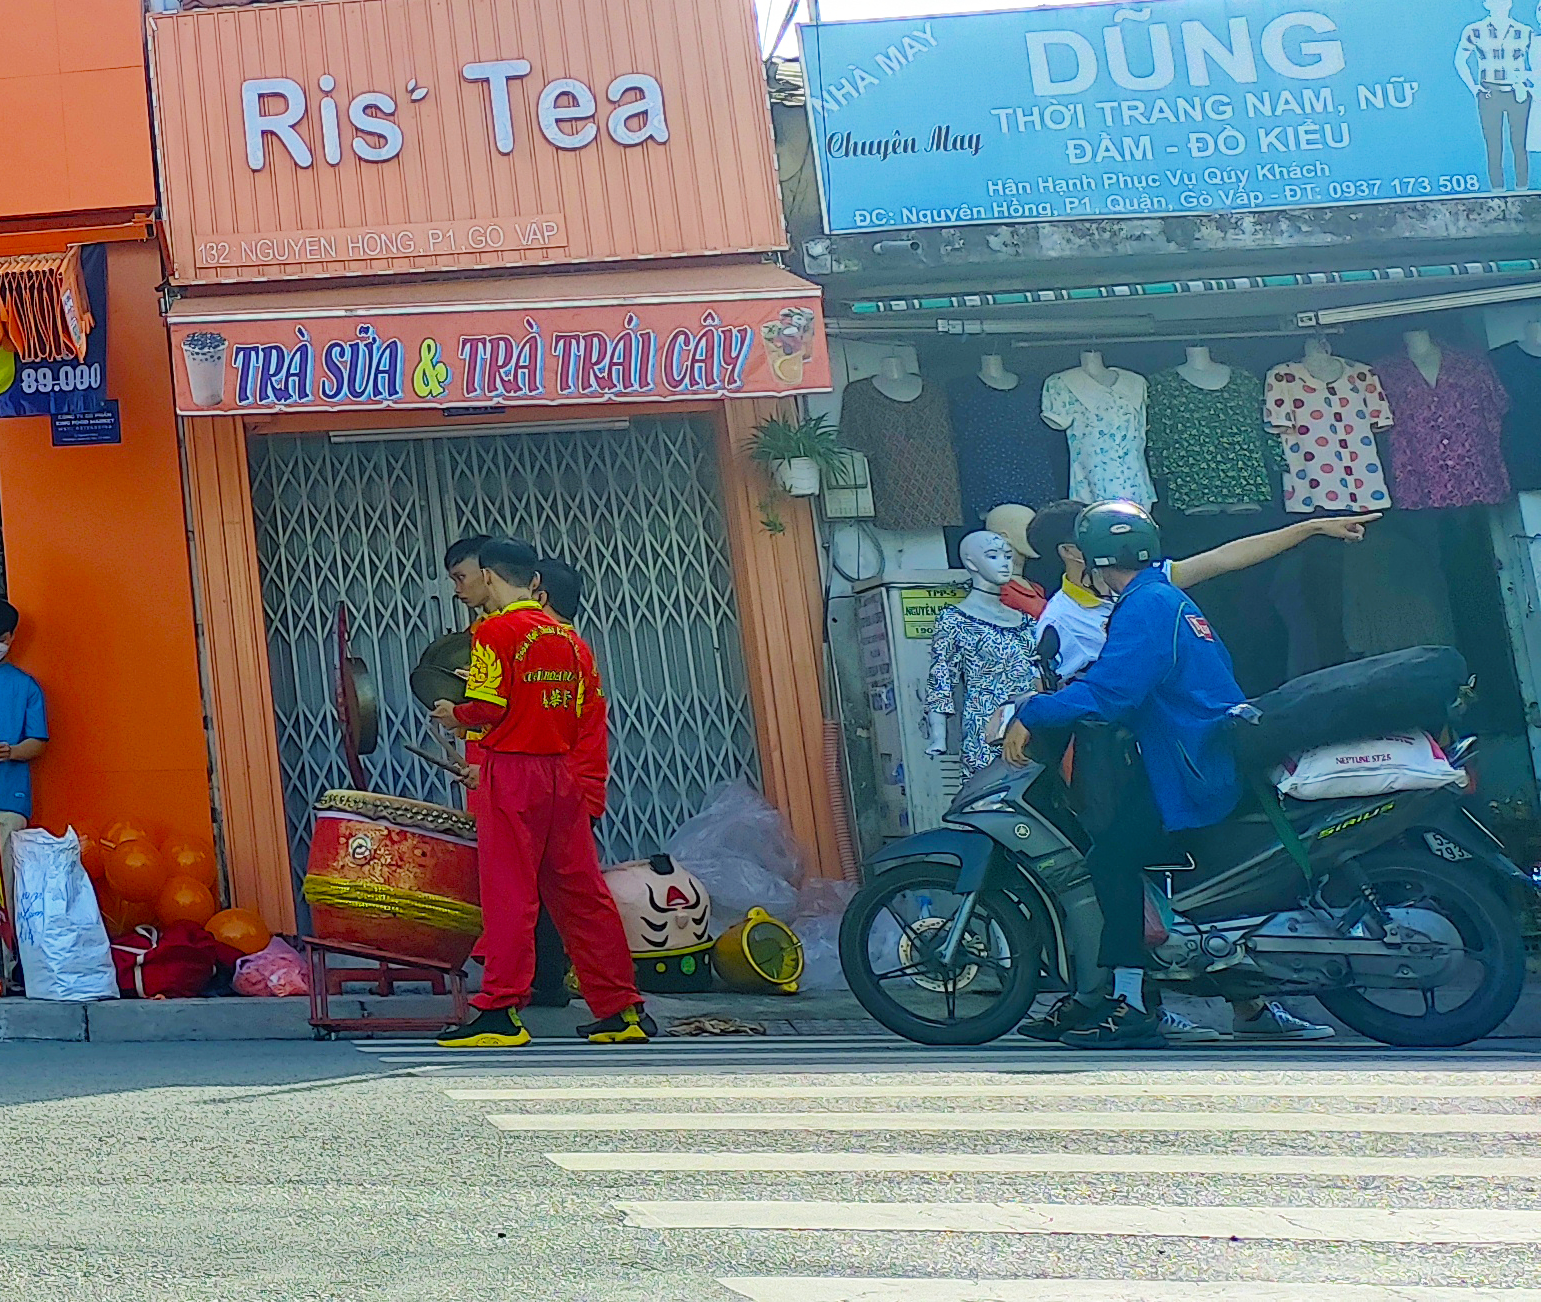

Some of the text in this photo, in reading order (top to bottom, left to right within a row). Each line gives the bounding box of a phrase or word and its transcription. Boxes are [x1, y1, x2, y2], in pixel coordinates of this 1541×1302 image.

[811, 22, 939, 118] NHÀ MAY
[1025, 7, 1346, 96] DŨNG
[462, 60, 669, 156] Tea
[991, 77, 1418, 133] THỜI TRANG NAM, NỮ
[827, 125, 984, 161] Chuyên May
[1259, 118, 1351, 153] KIỂU
[854, 209, 895, 227] ĐC:
[993, 197, 1057, 220] Hồng,
[1180, 187, 1213, 207] Gò
[1218, 185, 1262, 208] Vấp
[1284, 183, 1321, 200] ĐT:
[1328, 180, 1381, 198] 0937
[1392, 177, 1431, 195] 173
[1439, 175, 1479, 192] 508
[987, 179, 1031, 197] Hân
[1038, 174, 1095, 197] Hạnh
[1103, 171, 1160, 192] Phục
[1167, 170, 1197, 187] Vụ
[1257, 162, 1329, 182] Khách
[516, 219, 558, 246] VẤP
[233, 309, 752, 406] TRÀ SỮA & TRÀ TRÁI CÂY
